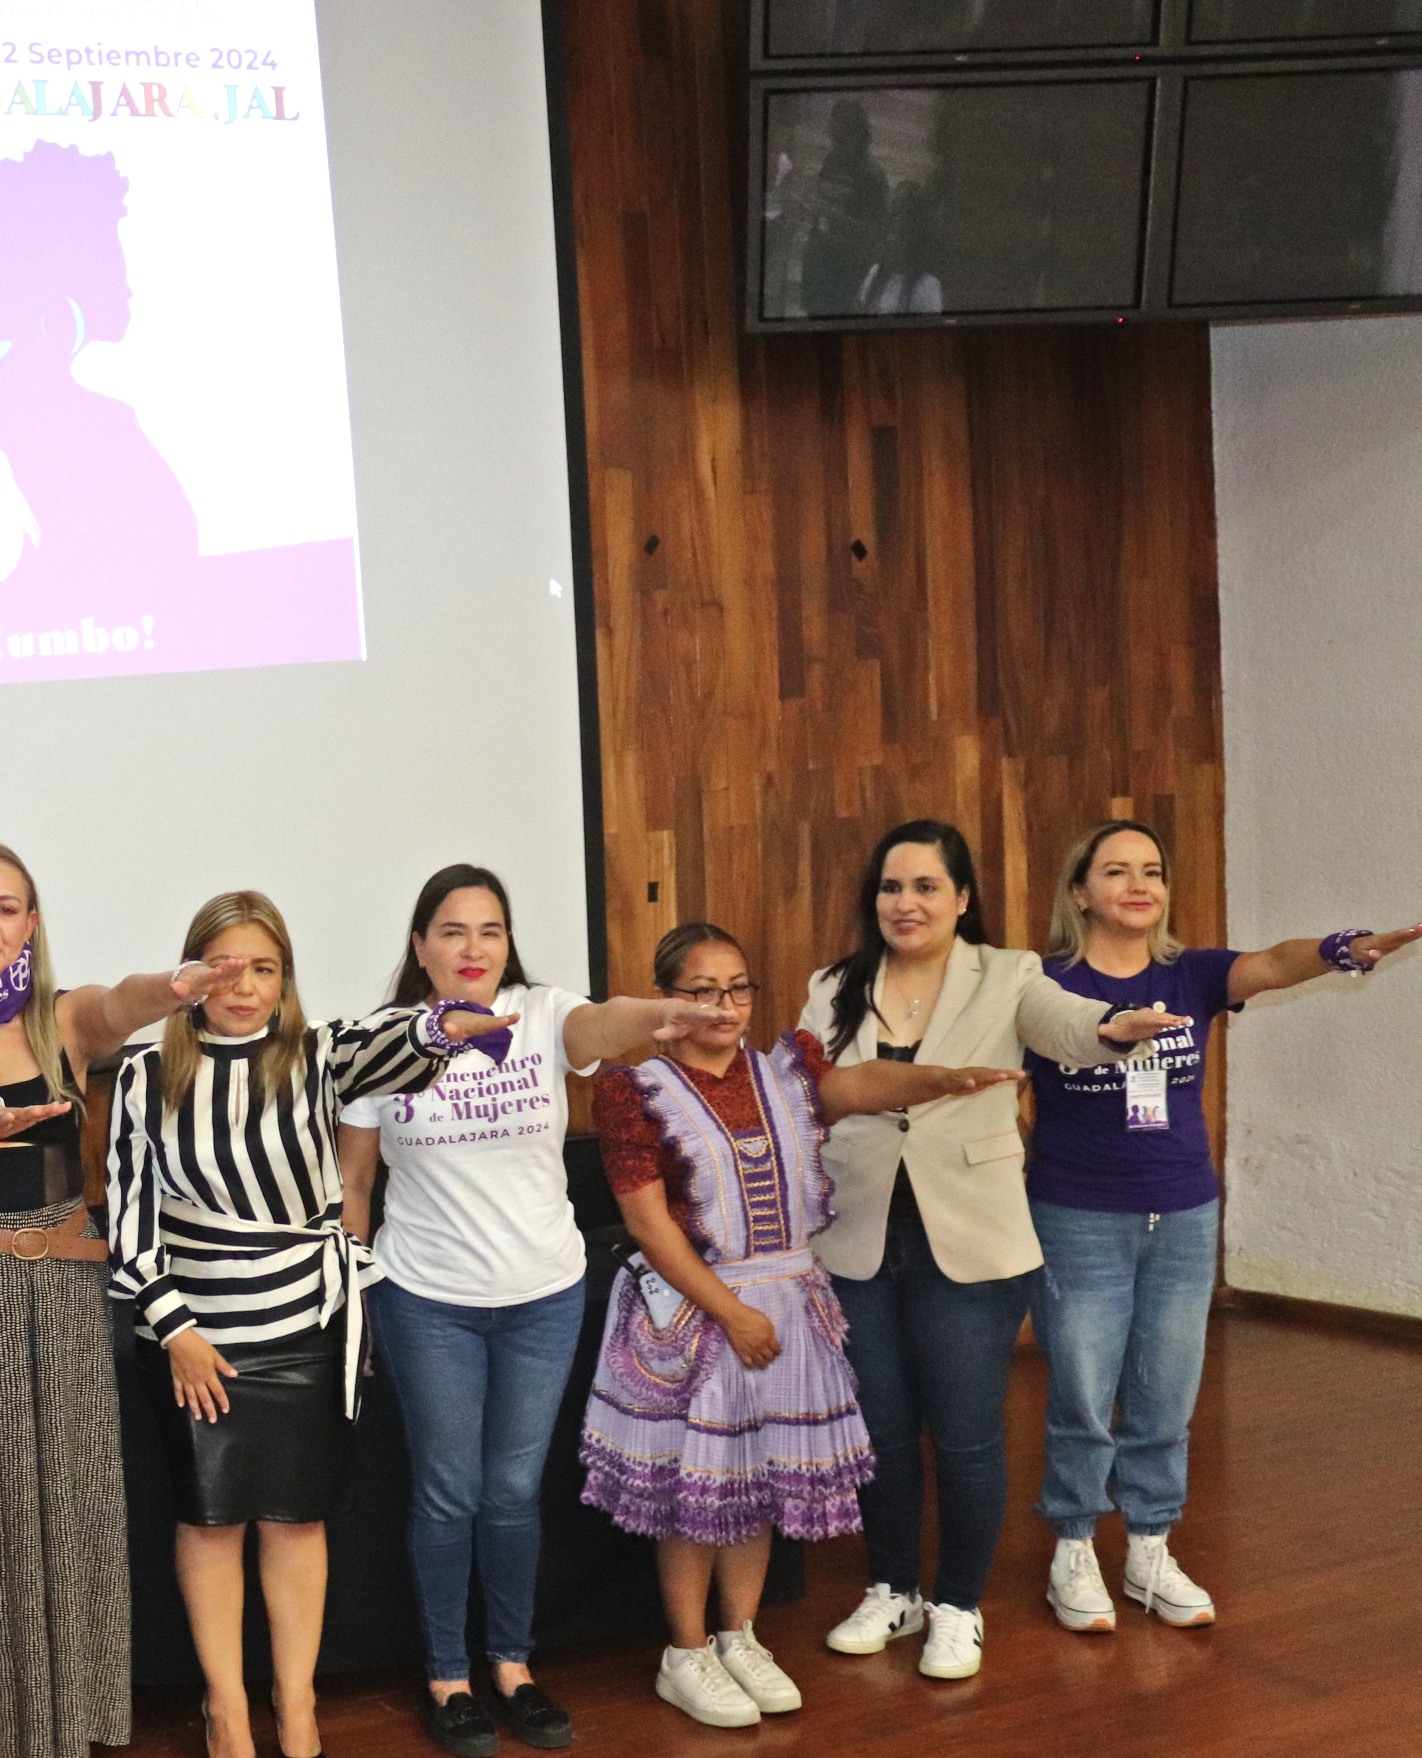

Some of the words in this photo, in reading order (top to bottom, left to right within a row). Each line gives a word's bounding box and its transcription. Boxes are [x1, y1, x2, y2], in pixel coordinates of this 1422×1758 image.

[28, 42, 200, 71] Septiembre
[210, 47, 278, 71] 2024
[1094, 1065, 1109, 1075] de
[432, 1068, 539, 1102] Nacional
[1064, 1081, 1127, 1092] GUADAL
[429, 1112, 444, 1123] de
[451, 1093, 551, 1124] Mujeres
[397, 1128, 511, 1147] GUADALAJARA
[517, 1122, 550, 1136] 2024
